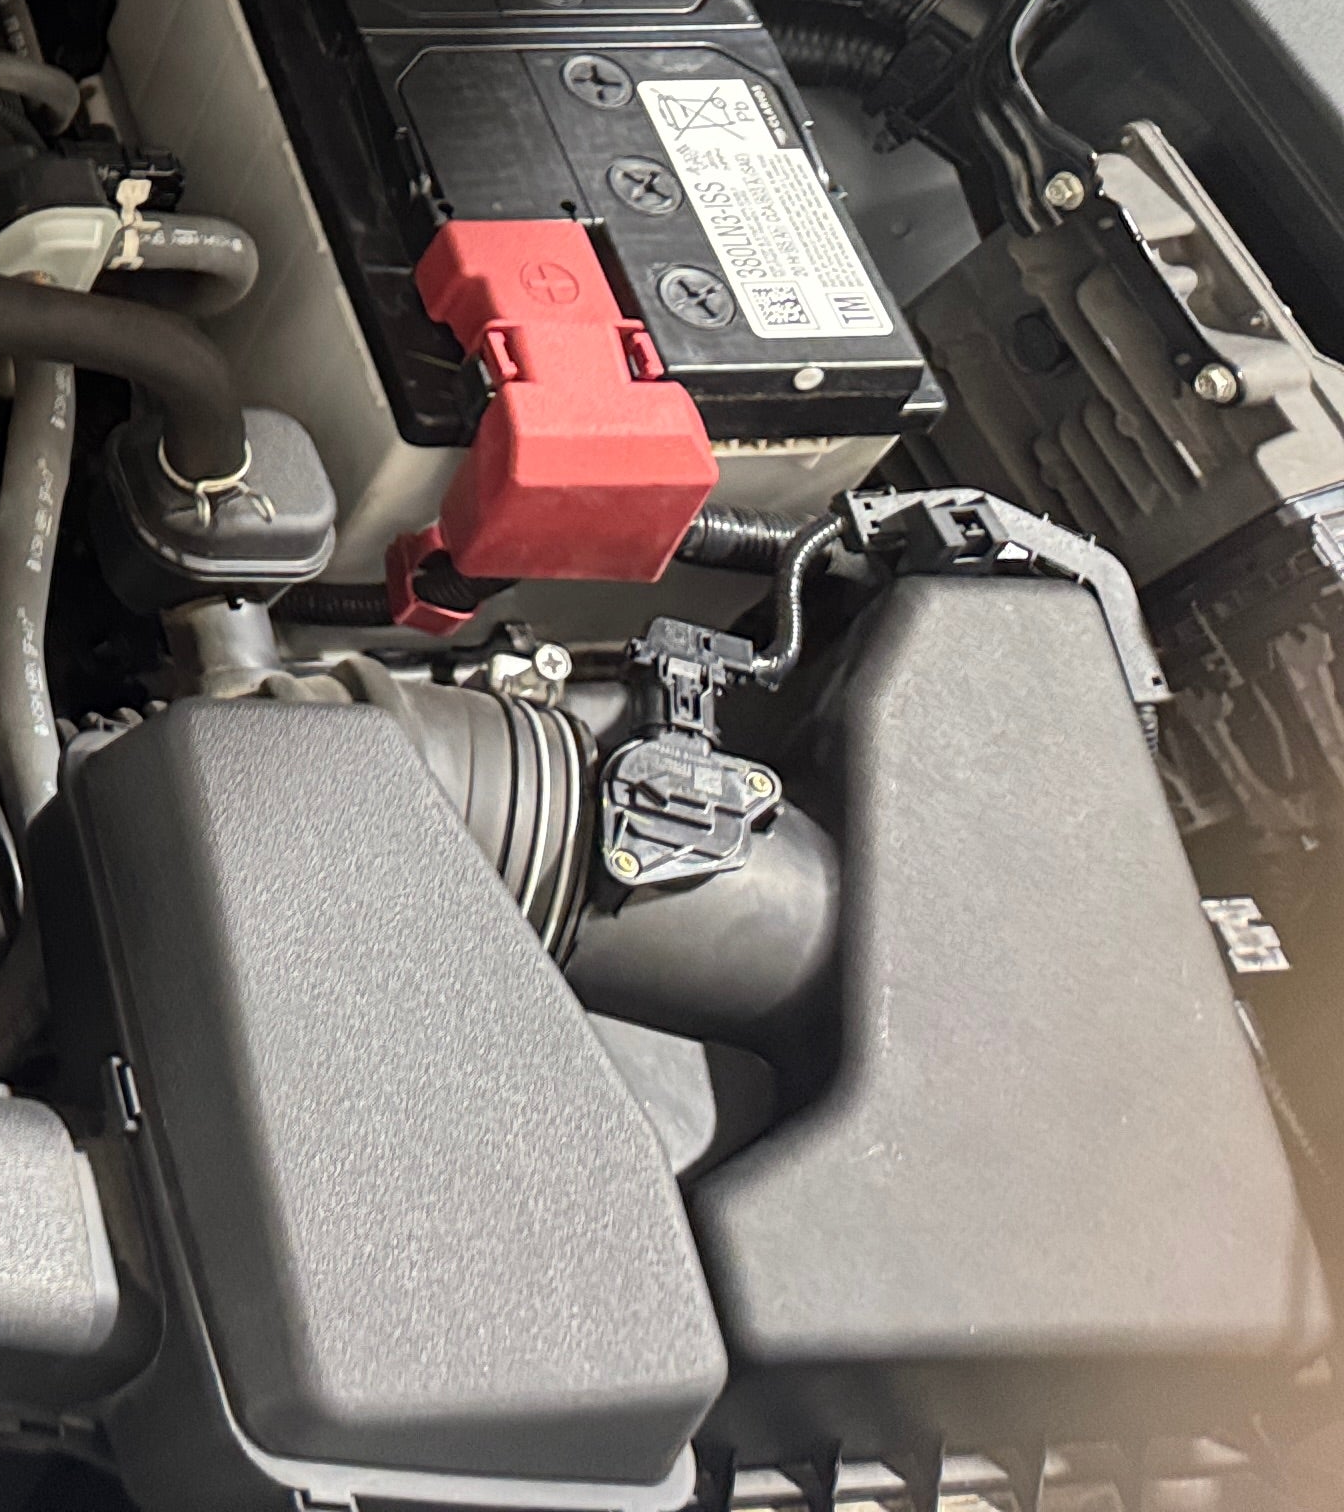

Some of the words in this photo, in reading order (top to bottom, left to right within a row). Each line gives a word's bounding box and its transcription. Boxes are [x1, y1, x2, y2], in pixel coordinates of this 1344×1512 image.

[733, 101, 755, 122] Pb
[694, 181, 767, 279] 380LN3-ISS
[833, 296, 875, 324] TM
